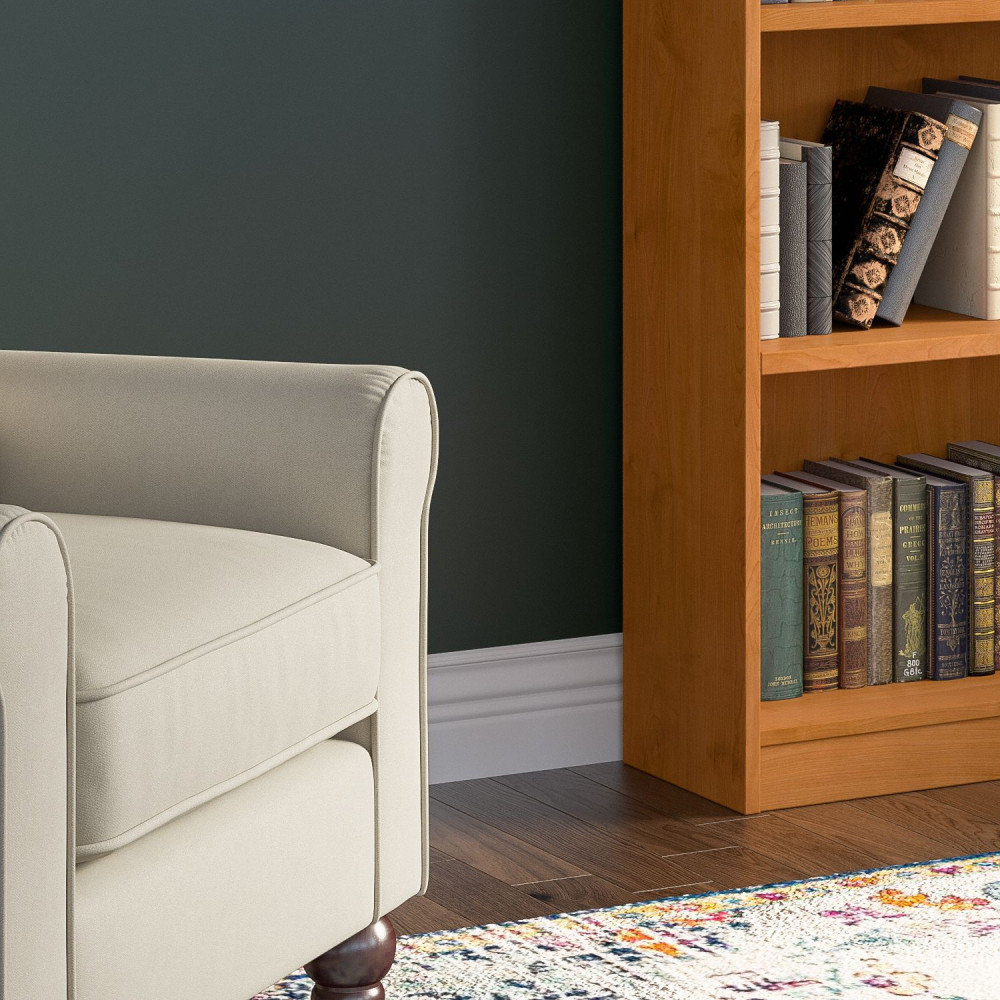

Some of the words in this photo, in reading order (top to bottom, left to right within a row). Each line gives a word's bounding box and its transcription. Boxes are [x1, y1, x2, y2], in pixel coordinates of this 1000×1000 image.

[769, 507, 799, 517] INSECT
[899, 503, 926, 512] COMME
[762, 519, 802, 530] ARCHITECTU
[805, 513, 839, 528] HEMANS
[899, 524, 926, 535] PRAIRI
[805, 536, 839, 548] POEMS
[912, 651, 918, 659] F
[906, 659, 920, 668] 800
